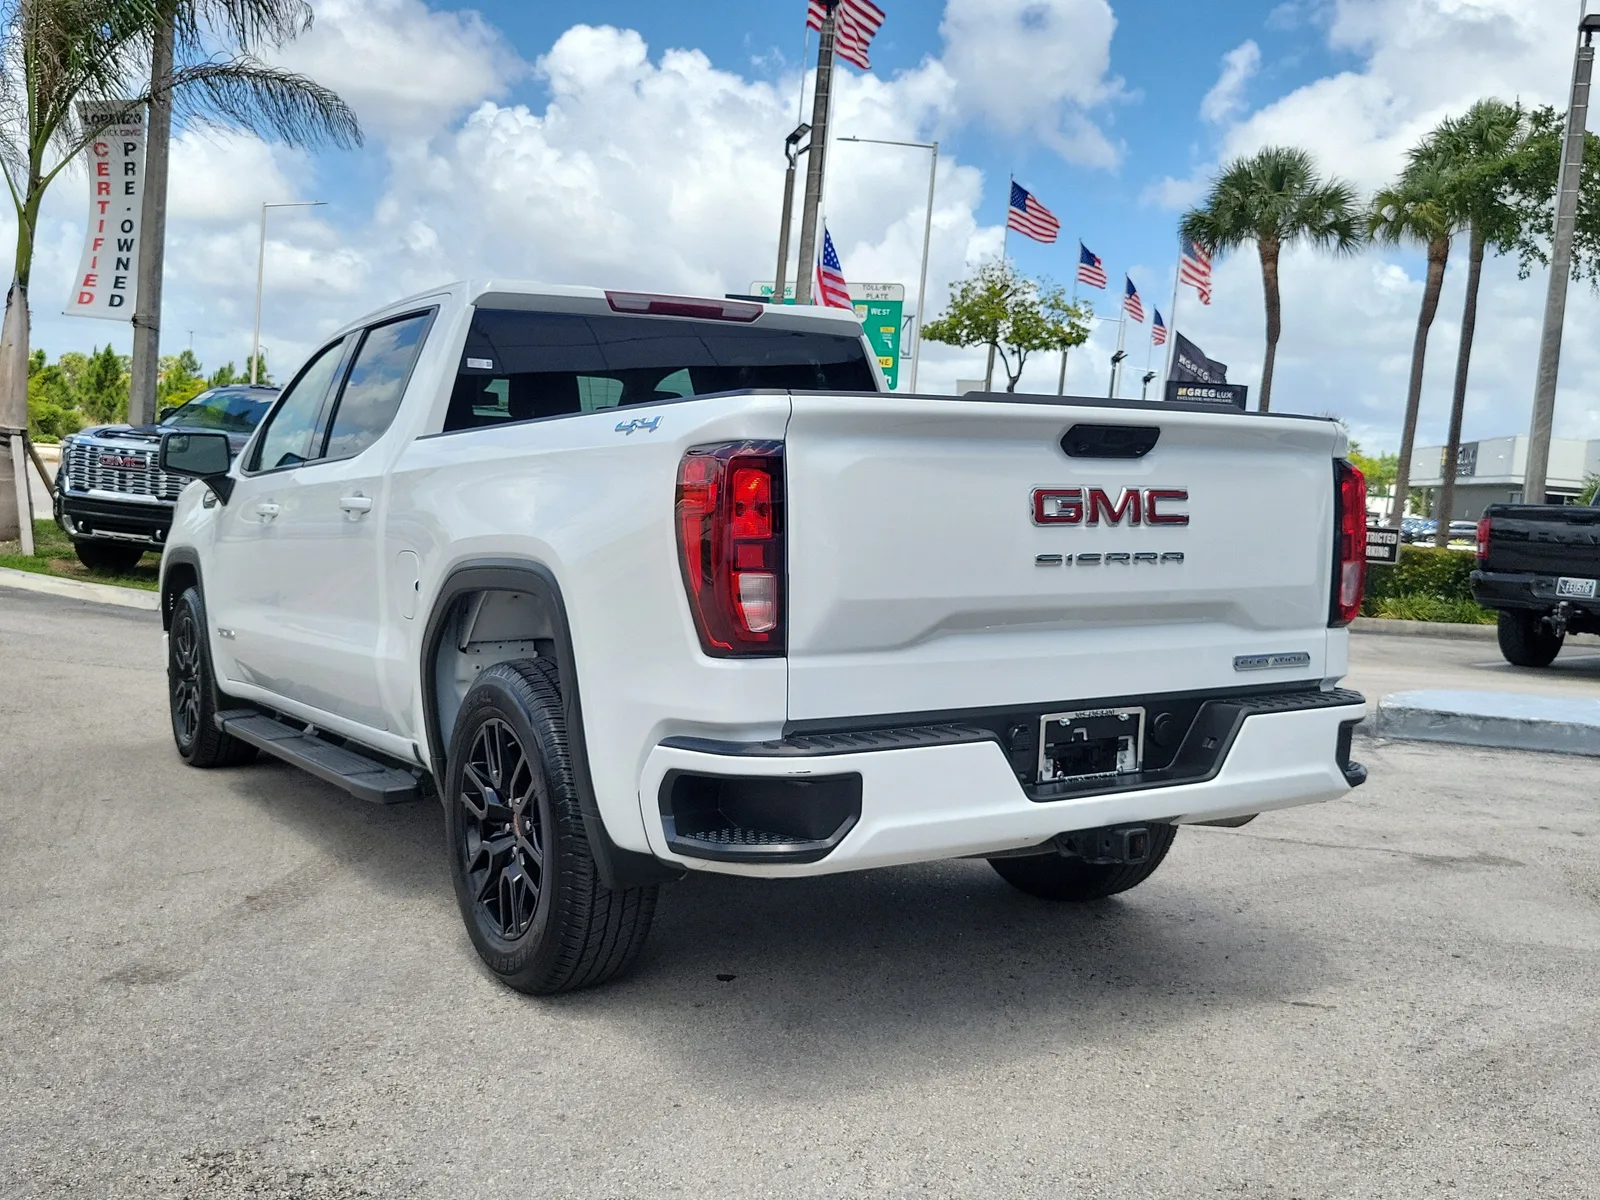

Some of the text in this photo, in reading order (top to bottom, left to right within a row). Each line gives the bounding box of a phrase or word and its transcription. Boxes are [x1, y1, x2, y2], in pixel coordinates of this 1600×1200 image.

[99, 129, 119, 137] UICK
[78, 142, 110, 305] CERTIFIED
[1185, 360, 1210, 381] GREG
[1187, 387, 1234, 399] GREG LUX
[100, 454, 147, 469] GMC
[1030, 484, 1190, 527] GMC
[1034, 551, 1185, 567] SIERRA
[1237, 655, 1307, 668] ELEVATION
